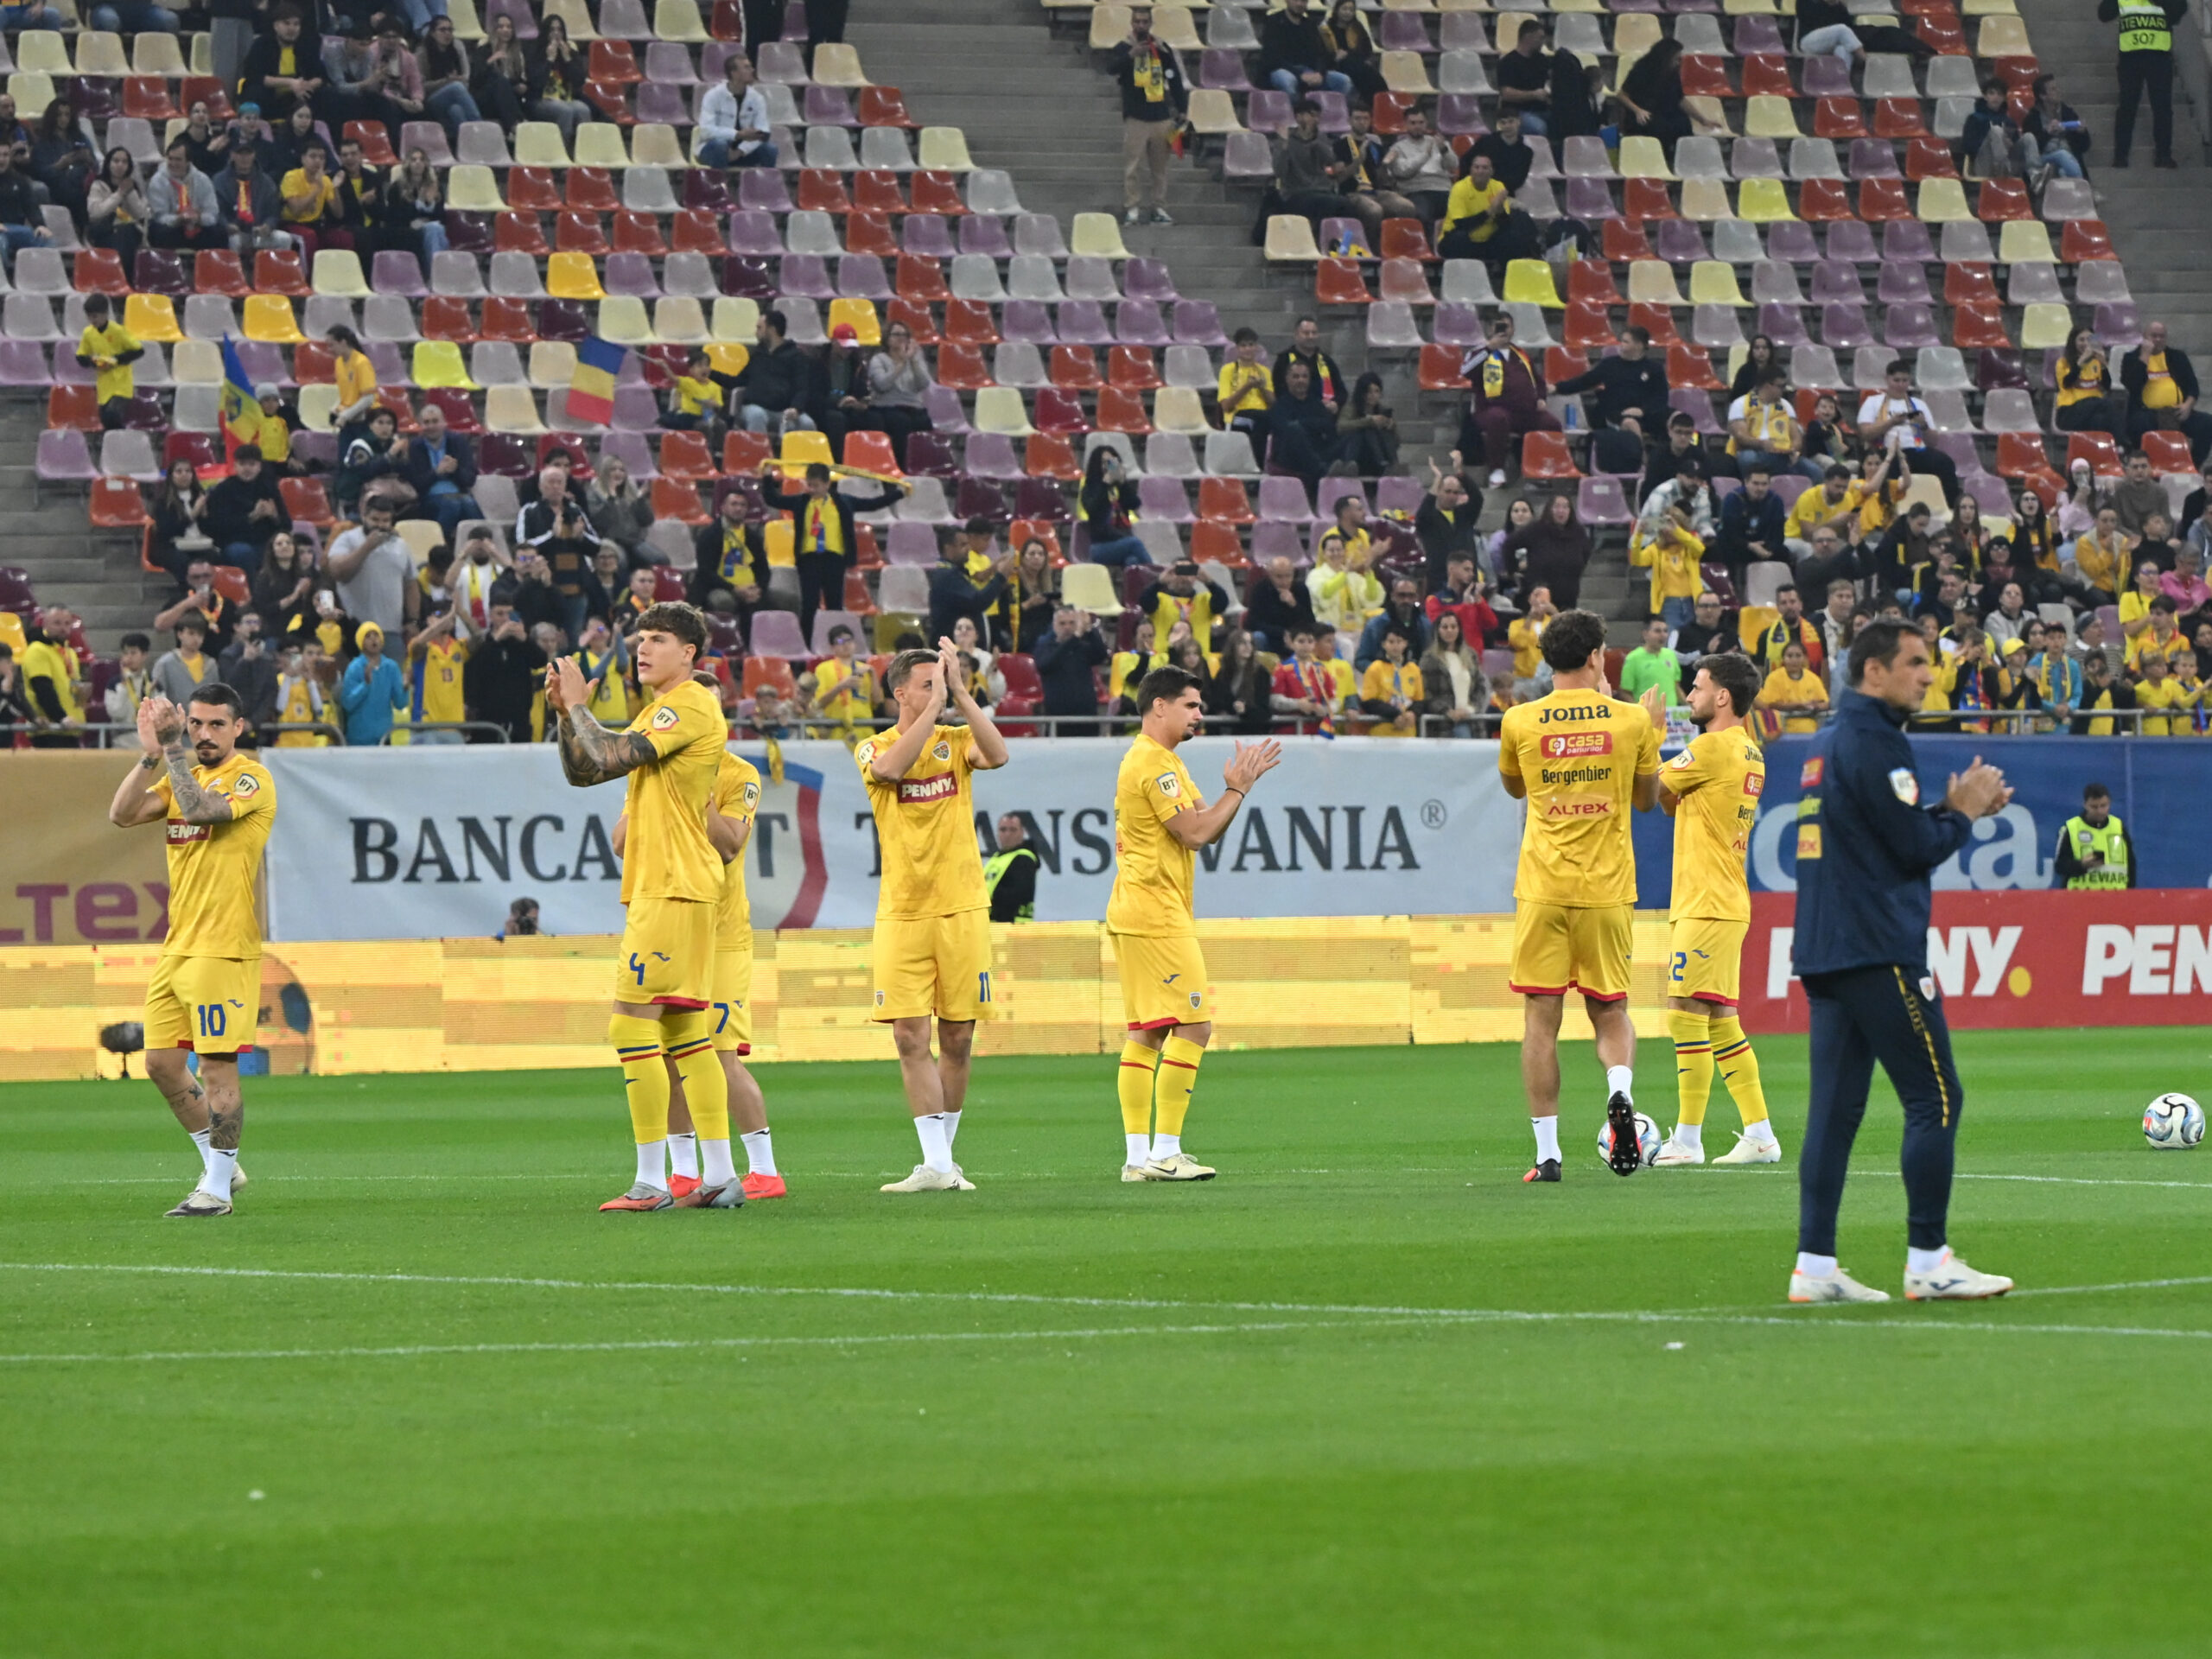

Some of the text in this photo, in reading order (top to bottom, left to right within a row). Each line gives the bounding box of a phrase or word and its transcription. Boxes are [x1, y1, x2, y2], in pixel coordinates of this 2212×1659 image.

[2132, 33, 2155, 46] 307
[657, 712, 672, 724] BT
[1567, 734, 1605, 747] casa
[1567, 746, 1604, 754] pariurilor
[1541, 766, 1612, 785] Bergenbier
[238, 779, 254, 792] BT
[1161, 779, 1176, 791] BT
[349, 814, 622, 882] BANCA
[2072, 871, 2127, 883] STEWAR
[629, 952, 645, 986] 4
[1669, 951, 1688, 981] 2
[978, 971, 991, 1002] 11
[198, 1003, 226, 1037] 10
